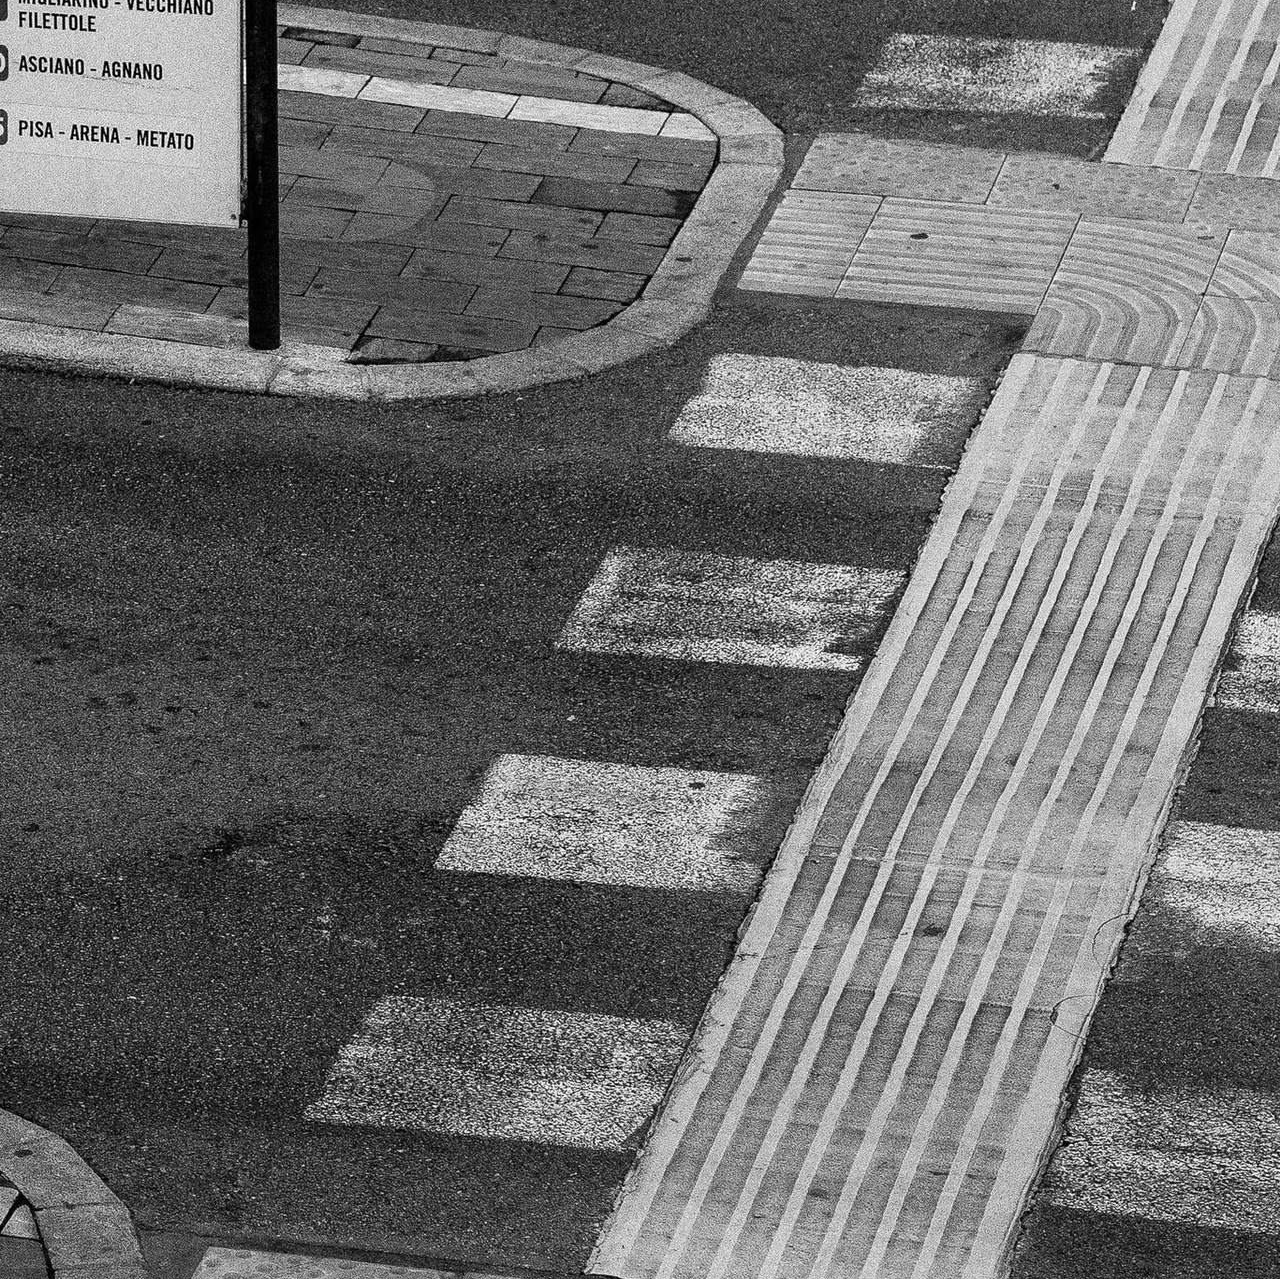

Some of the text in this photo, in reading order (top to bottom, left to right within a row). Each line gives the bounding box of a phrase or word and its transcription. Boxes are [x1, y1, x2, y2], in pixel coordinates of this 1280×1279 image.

[19, 12, 97, 33] FILETTOLE
[18, 55, 86, 77] ASCIANO
[101, 60, 164, 82] AGNANO
[18, 119, 55, 140] PISA
[69, 123, 120, 145] ARENA
[136, 129, 195, 151] METATO
